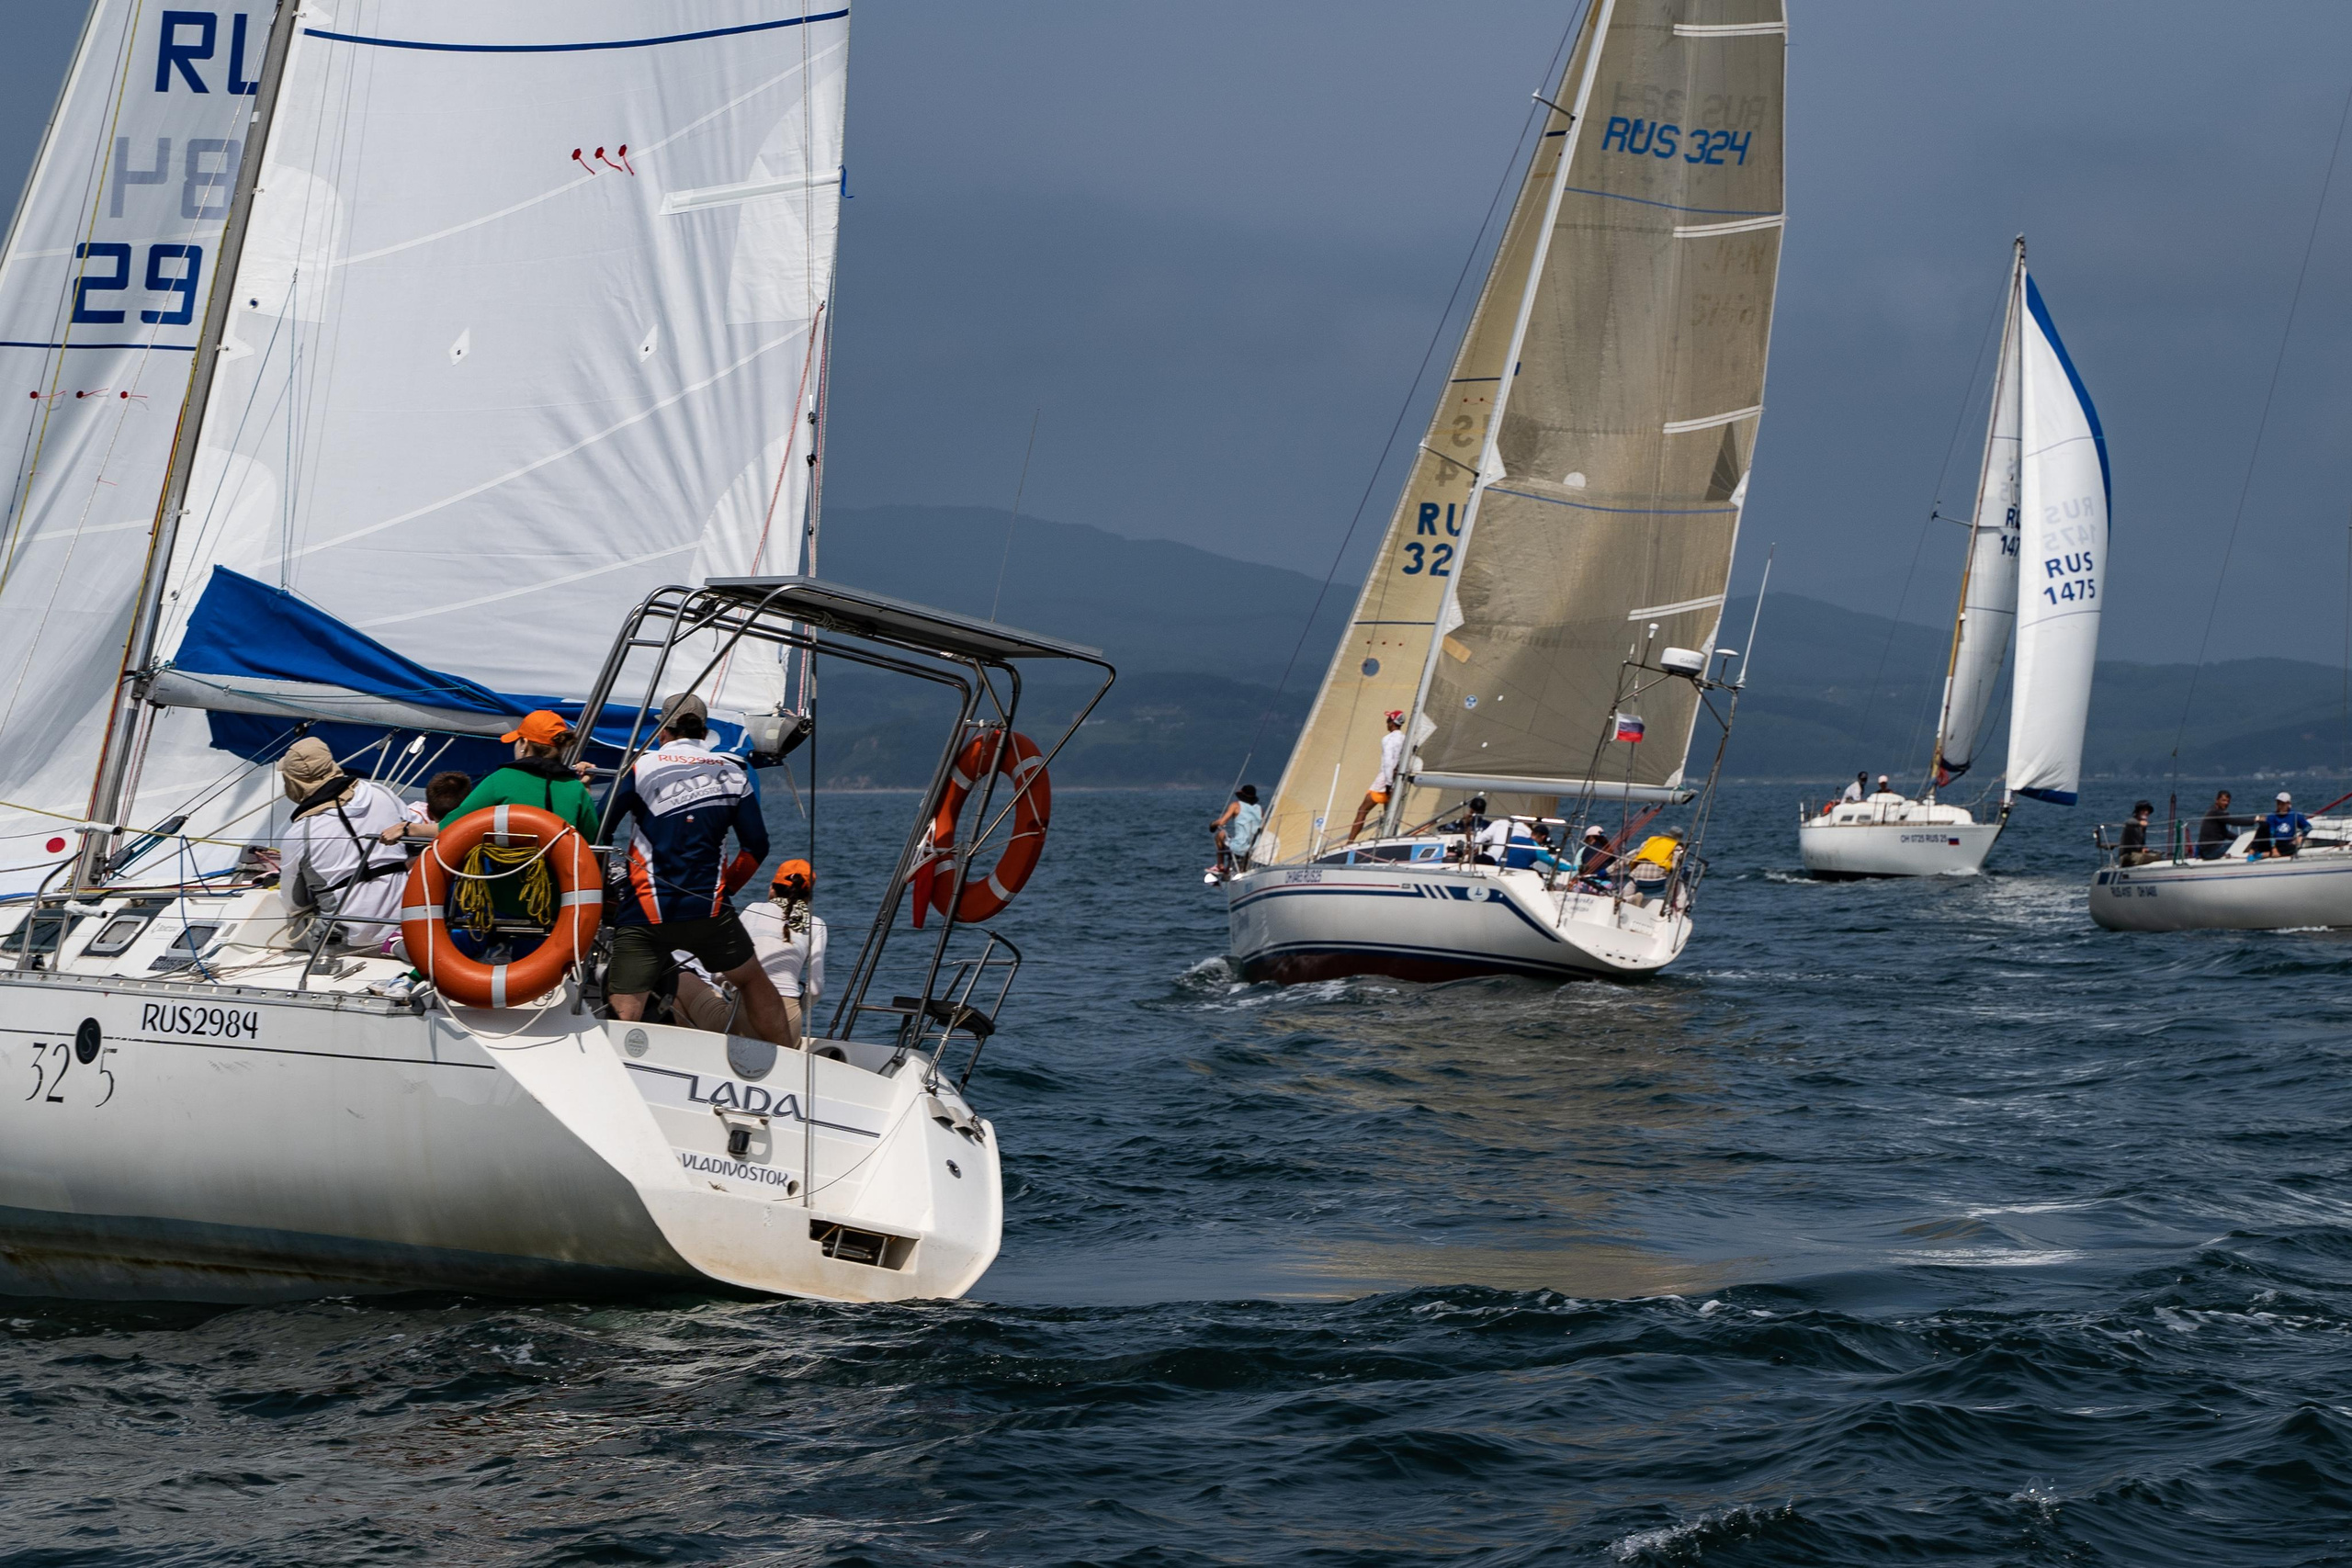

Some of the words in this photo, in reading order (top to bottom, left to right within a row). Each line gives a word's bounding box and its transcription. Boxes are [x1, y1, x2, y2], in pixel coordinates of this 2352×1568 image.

[1601, 116, 1680, 159] RUS
[1684, 130, 1751, 165] 324
[71, 242, 203, 325] 29
[1402, 542, 1454, 577] 32
[2044, 551, 2094, 580] RUS
[2043, 579, 2096, 605] 1475
[654, 769, 743, 804] LADA
[141, 1002, 259, 1040] RUS2984
[686, 1075, 807, 1122] LADA
[682, 1153, 790, 1188] VLADIVOSTOK
